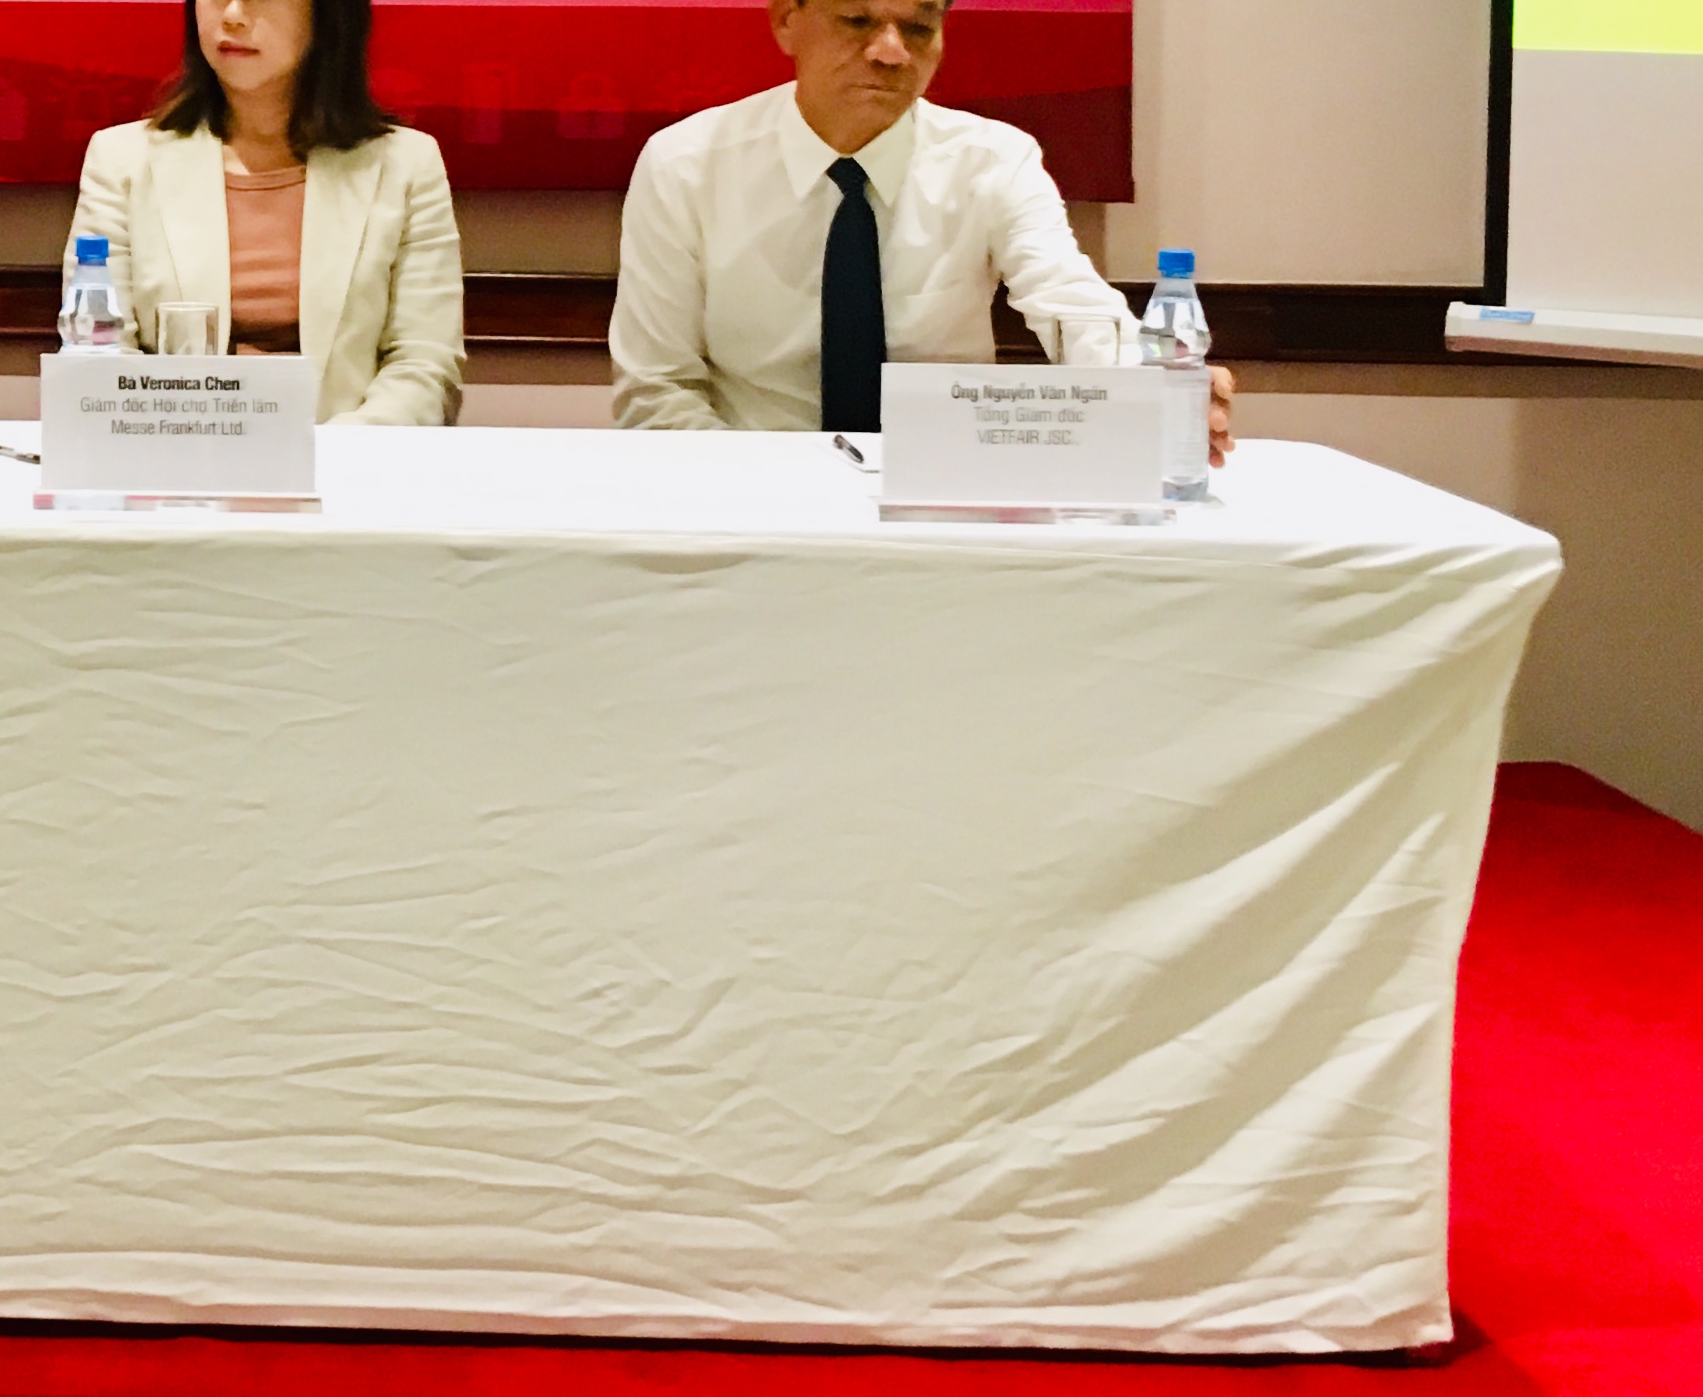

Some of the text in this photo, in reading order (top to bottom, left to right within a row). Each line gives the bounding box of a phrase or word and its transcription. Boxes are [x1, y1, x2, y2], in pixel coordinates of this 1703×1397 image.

[140, 375, 201, 391] Veronica
[204, 376, 241, 391] Chen
[111, 419, 155, 435] Messe
[159, 419, 217, 435] Frankfurt
[977, 428, 1040, 445] VIETFAIR
